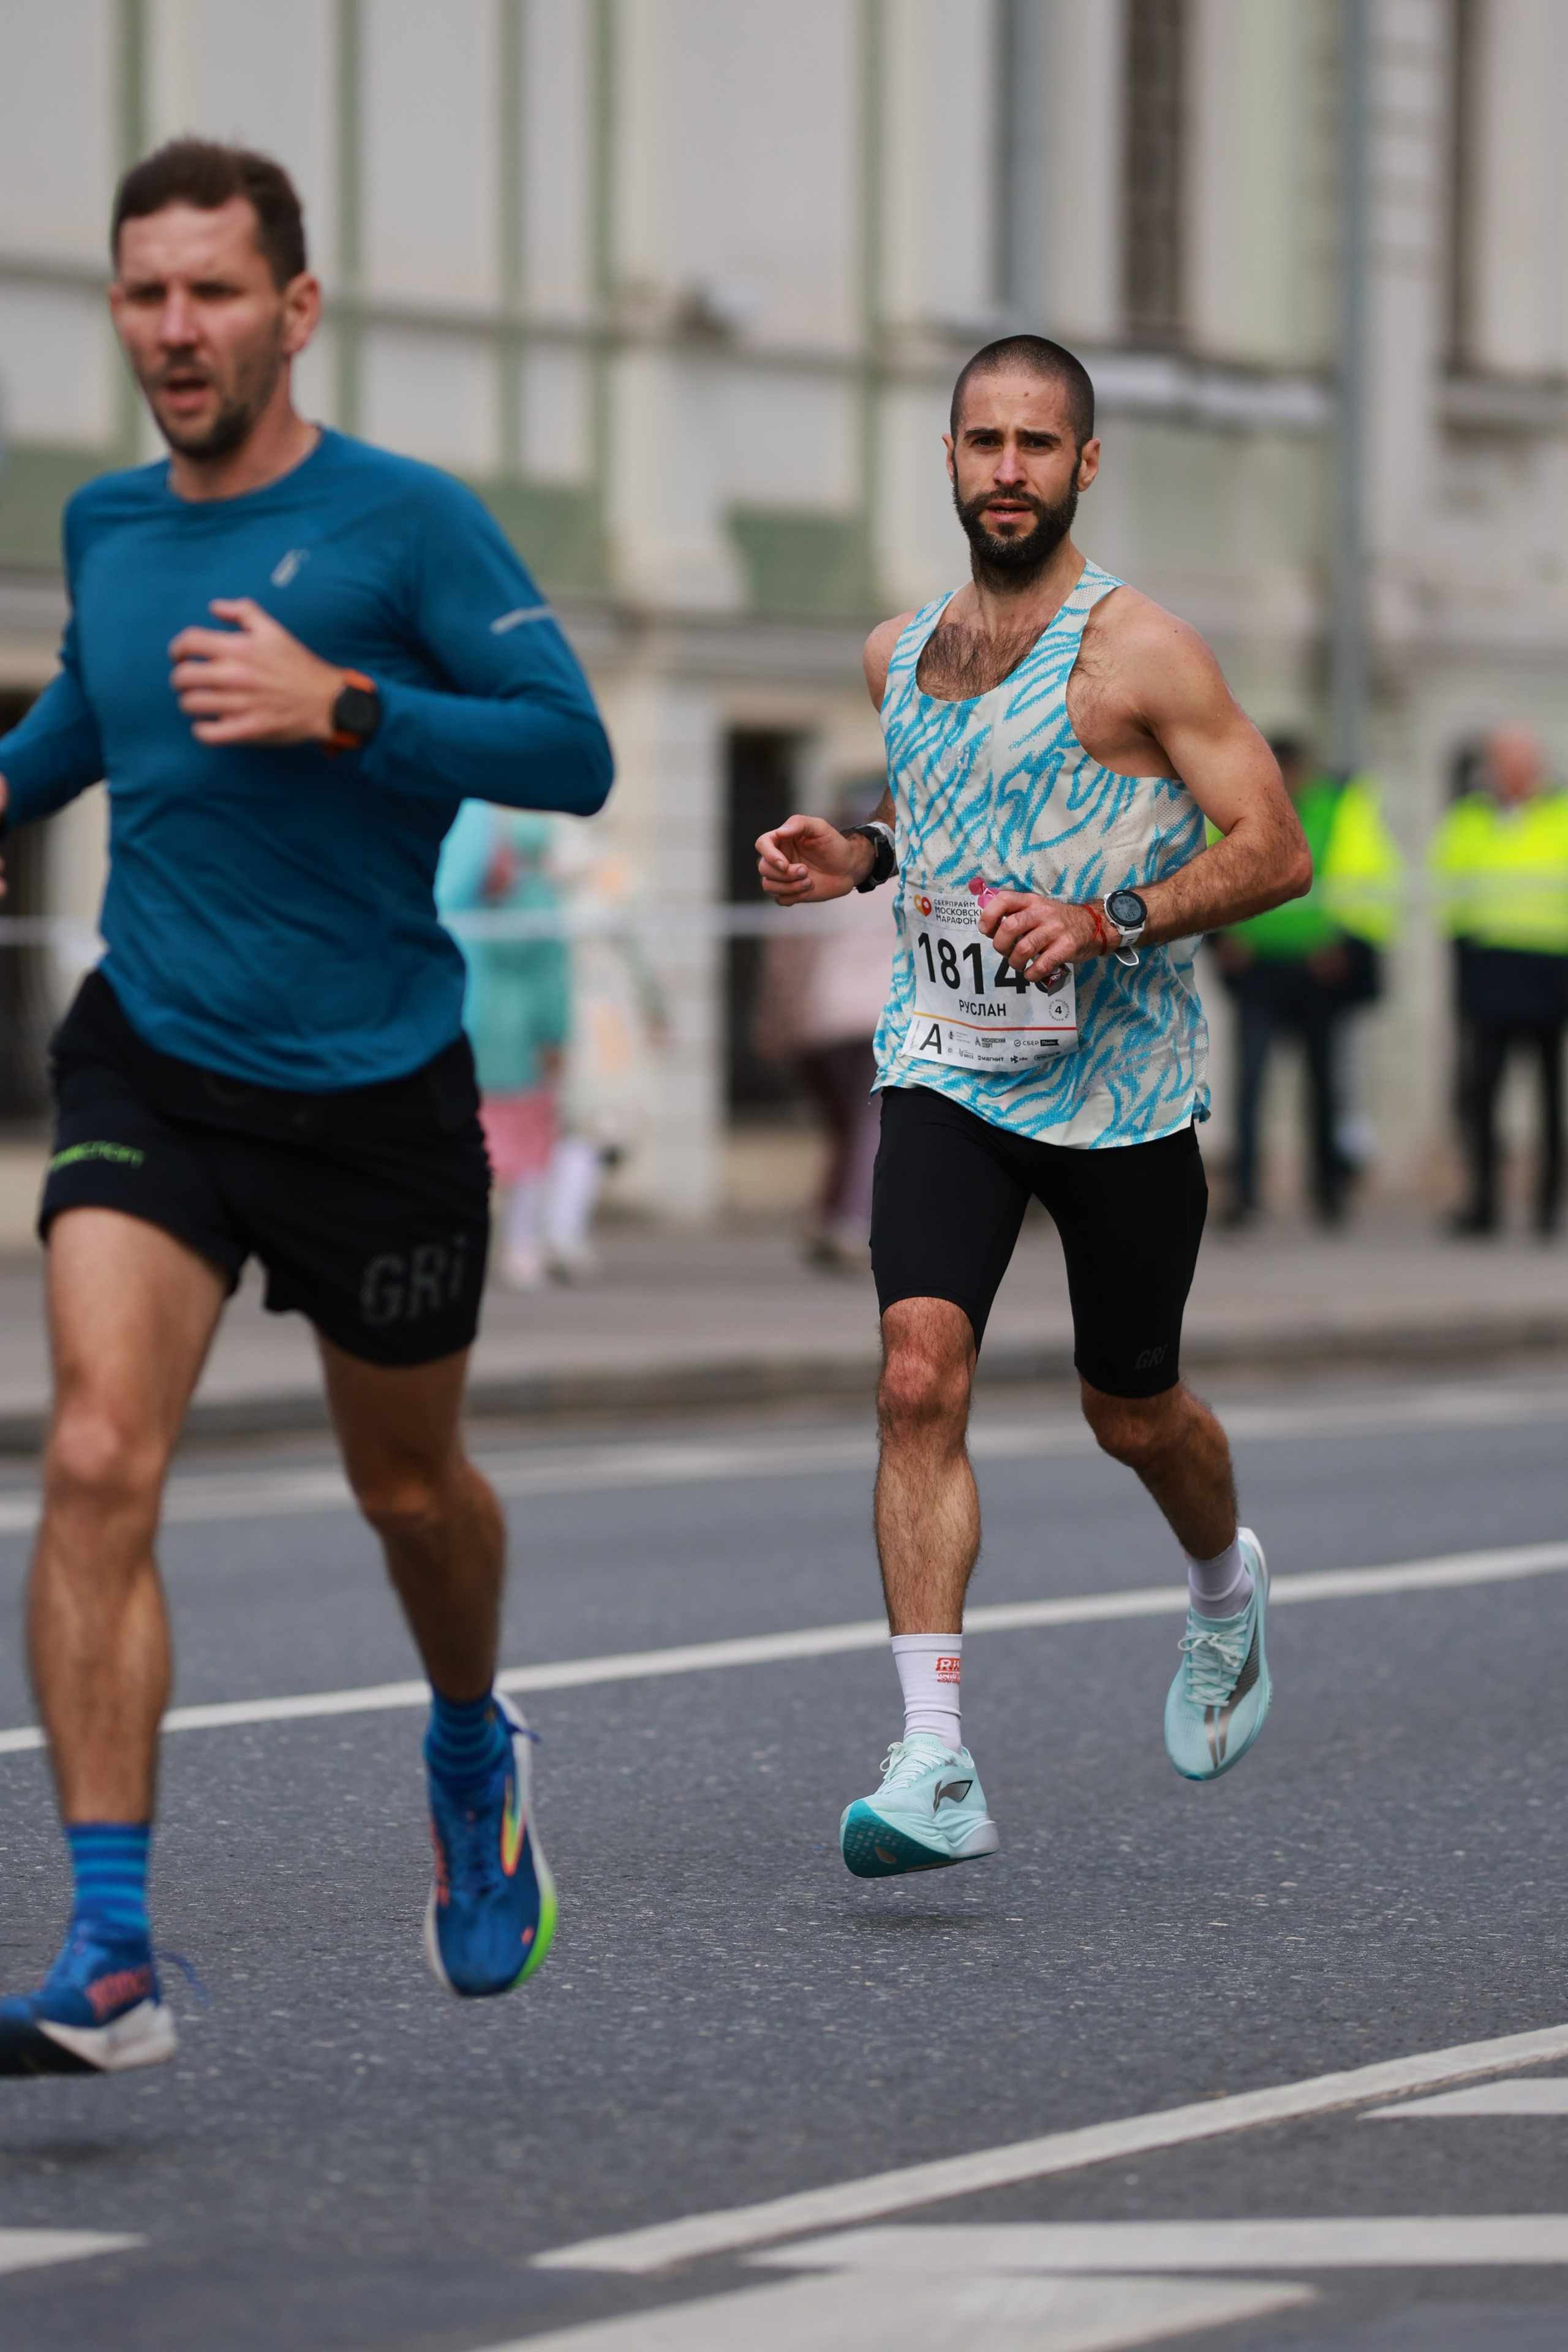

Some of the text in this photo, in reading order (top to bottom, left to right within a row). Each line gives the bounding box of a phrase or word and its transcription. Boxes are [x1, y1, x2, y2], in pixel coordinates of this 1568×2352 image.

[936, 914, 976, 924] МАРАФОН
[918, 932, 1048, 995] 1814
[959, 999, 1006, 1016] РУСЛАН
